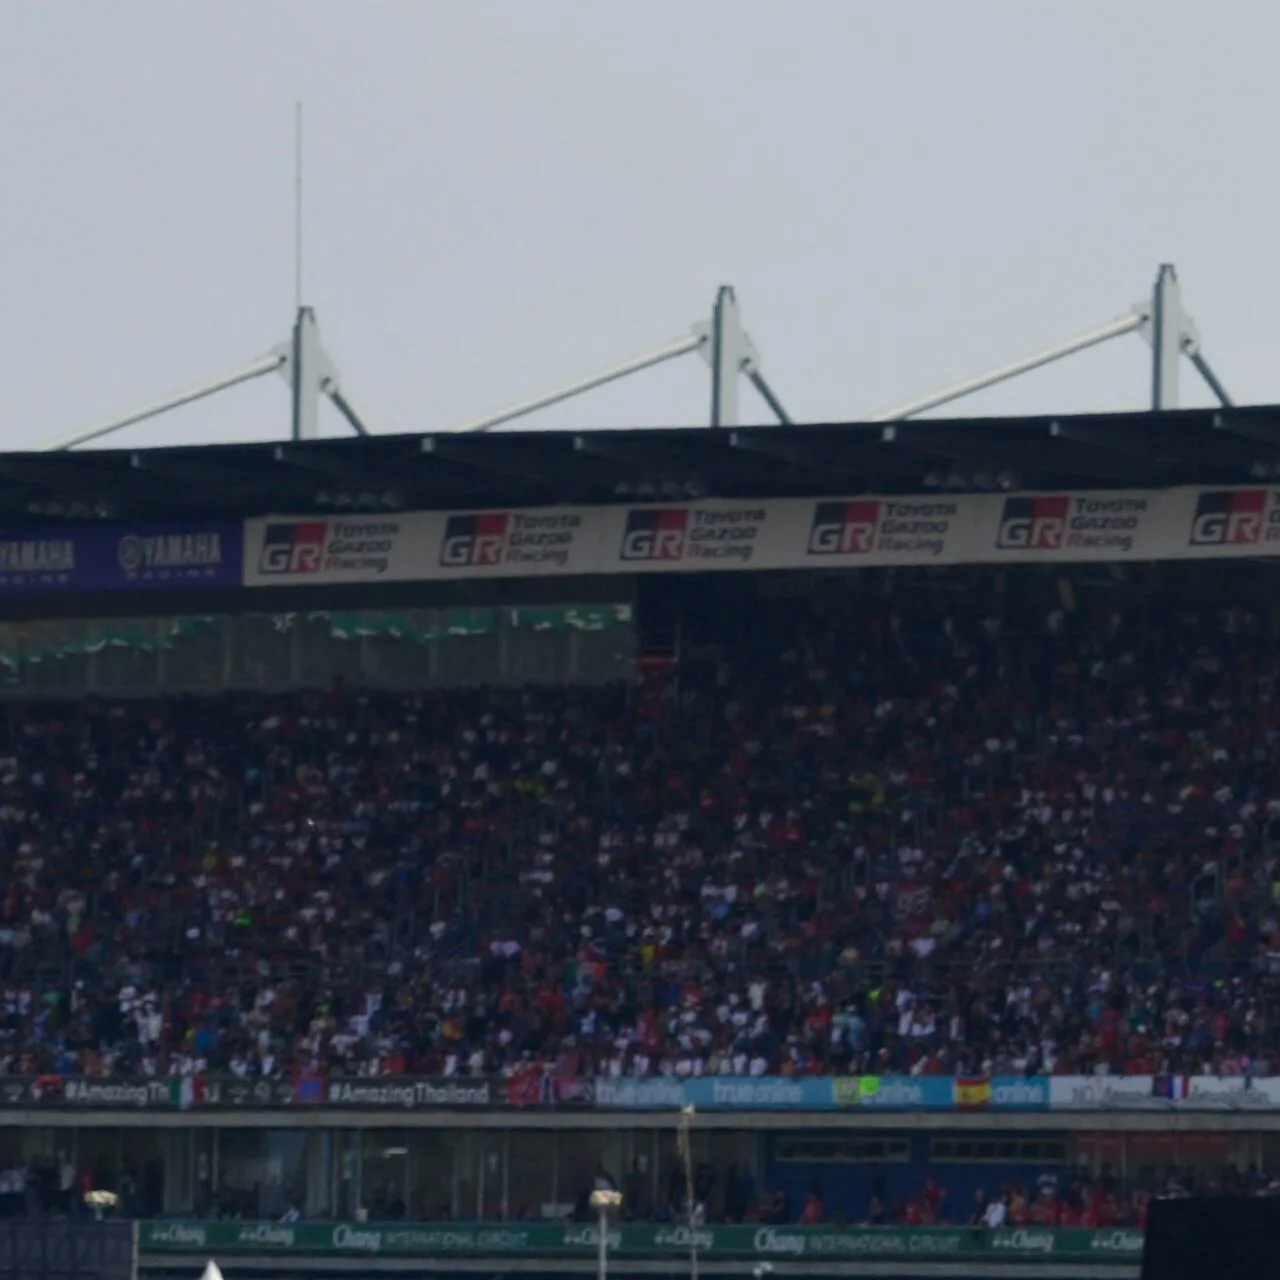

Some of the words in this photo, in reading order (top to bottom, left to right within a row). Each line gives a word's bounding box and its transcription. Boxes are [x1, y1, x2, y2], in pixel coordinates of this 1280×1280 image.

[885, 502, 957, 517] TOYOTA
[1074, 497, 1148, 514] TOYOTA
[513, 513, 581, 529] TOYOTA
[693, 508, 767, 525] TOYOTA
[1069, 514, 1139, 531] GAZOO
[332, 522, 400, 538] TOYOTA
[690, 525, 758, 541] GAZOO
[881, 518, 949, 535] GAZOO
[327, 538, 392, 554] GAZOO
[509, 530, 574, 546] GAZOO
[876, 536, 945, 555] Racing
[1066, 532, 1134, 552] Racing
[144, 533, 223, 568] YAMAHA
[505, 547, 569, 565] Racing
[687, 542, 754, 561] Racing
[323, 555, 389, 573] Racing
[332, 1224, 382, 1252] Chang
[754, 1228, 806, 1255] Chang
